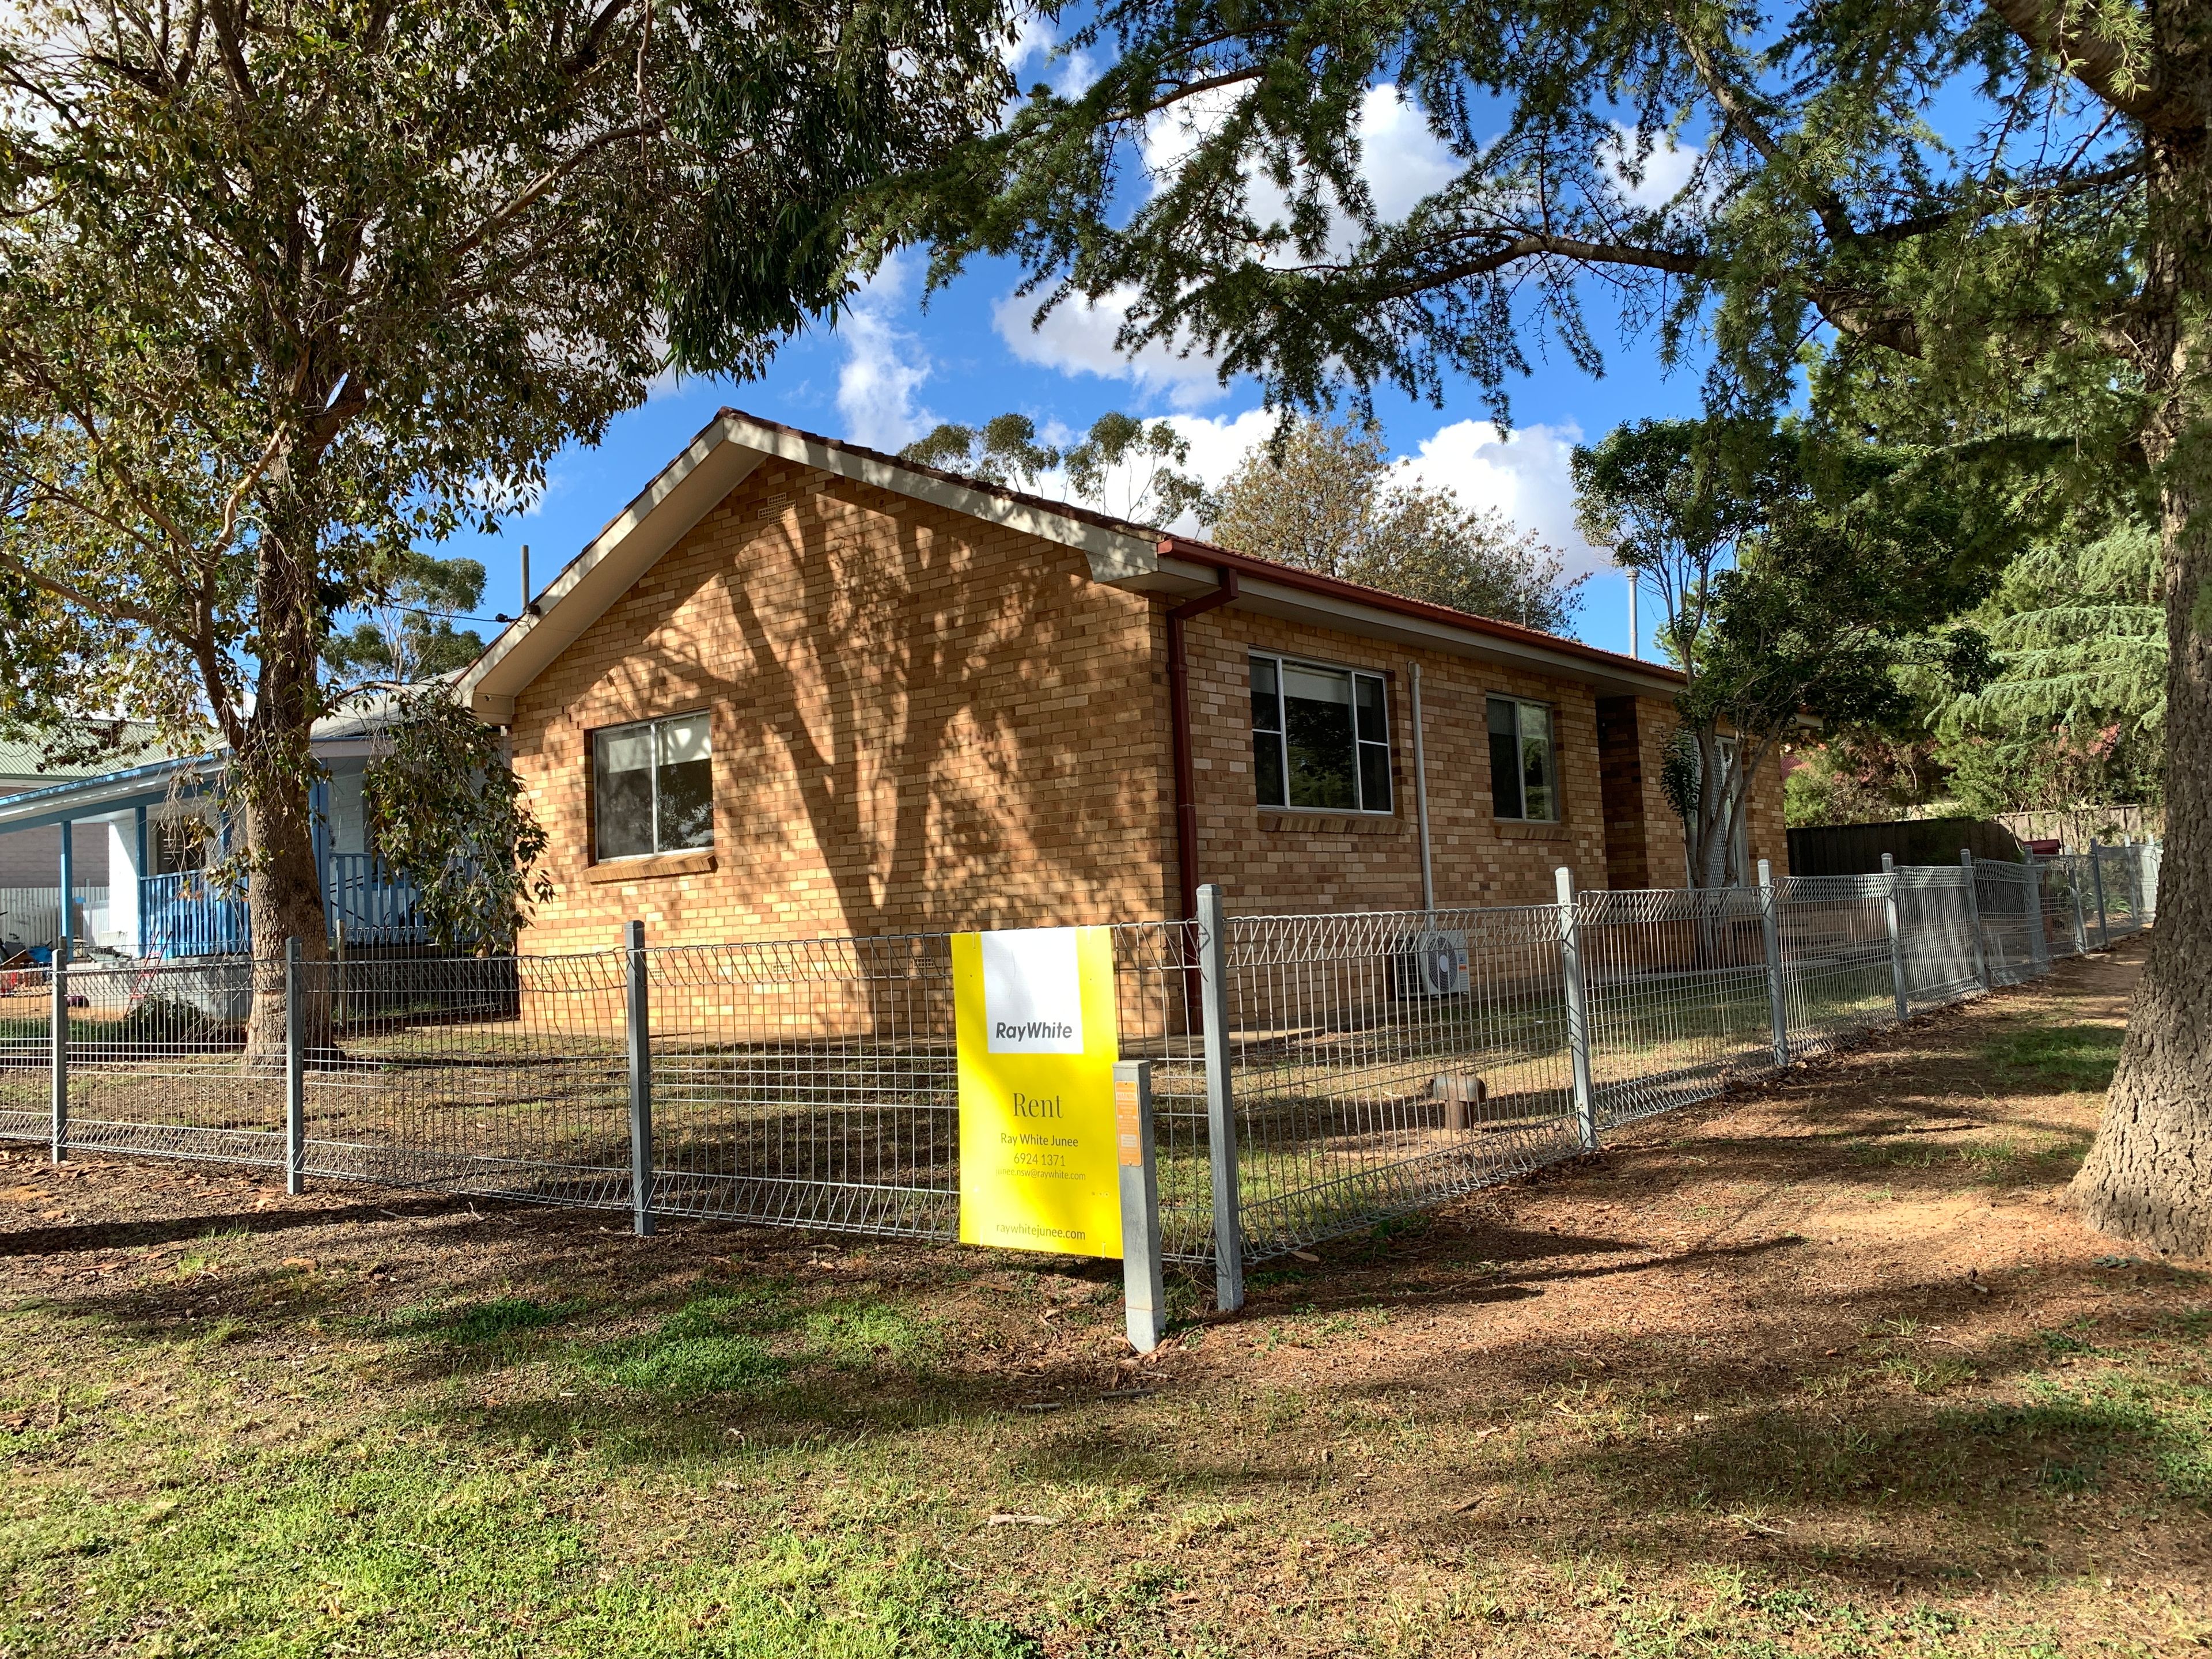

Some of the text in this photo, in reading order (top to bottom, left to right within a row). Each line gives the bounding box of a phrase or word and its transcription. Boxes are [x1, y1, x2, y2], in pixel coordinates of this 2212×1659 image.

[996, 1022, 1073, 1042] RayWhite
[1013, 1093, 1064, 1118] Rent
[1001, 1132, 1078, 1147] Ray White Junee
[1014, 1153, 1065, 1166] 6924 1371
[996, 1223, 1086, 1240] raywhitejunee.com
